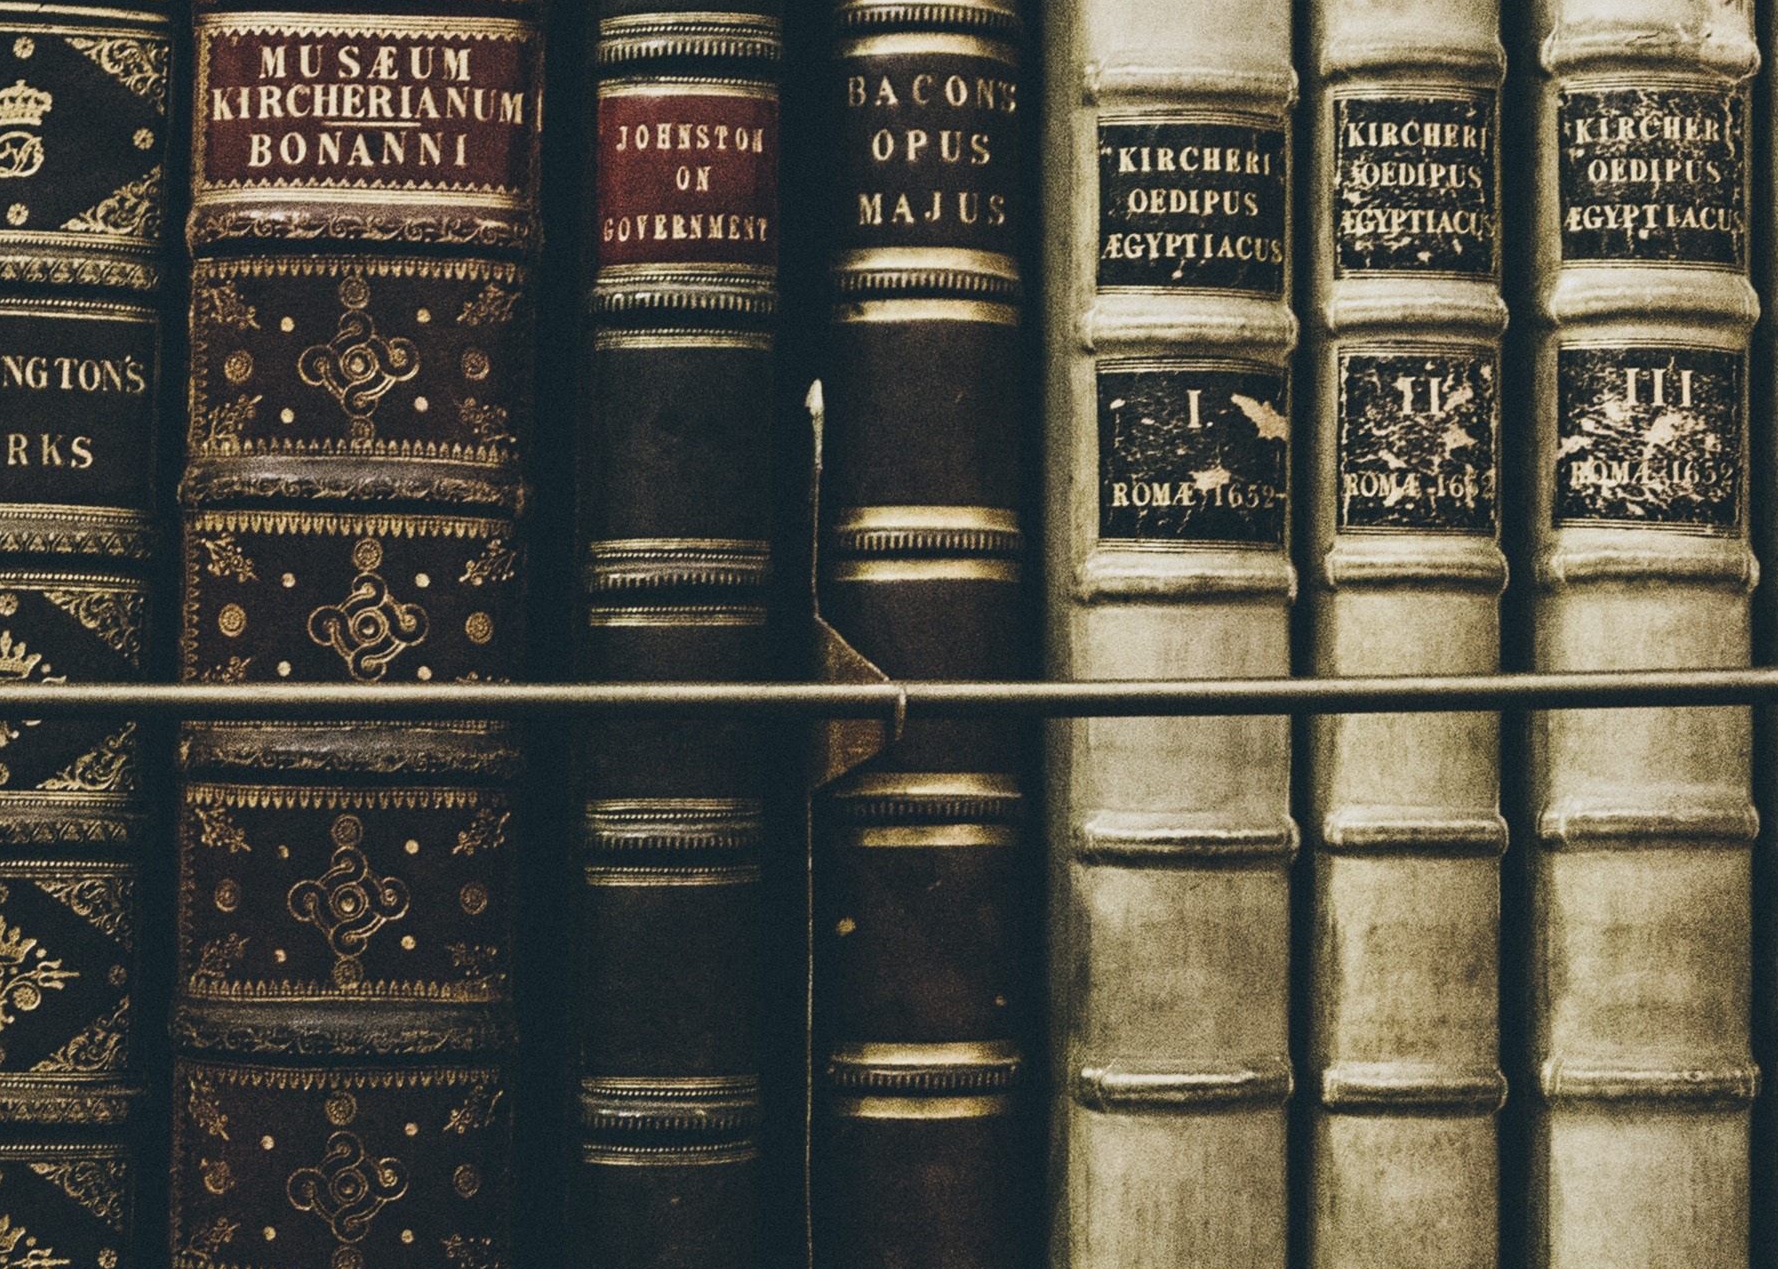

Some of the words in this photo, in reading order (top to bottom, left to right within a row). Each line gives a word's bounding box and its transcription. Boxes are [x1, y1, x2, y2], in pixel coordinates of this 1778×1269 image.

[258, 45, 471, 82] MUSÆUM
[210, 83, 524, 124] KIRCHERIANUM
[849, 75, 1017, 113] BACON'S
[248, 132, 467, 168] BONANNI
[616, 124, 764, 154] JOHNSTON
[872, 131, 990, 164] OPUS
[1347, 121, 1487, 149] KIRCHERI
[1118, 147, 1270, 176] KIRCHERI
[1361, 162, 1482, 188] OEDIPUS
[1588, 158, 1721, 184] OEDIPUS
[676, 166, 709, 192] ON
[858, 193, 1005, 226] MAJUS
[1128, 188, 1258, 217] OEDIPUS
[603, 215, 767, 242] GOVERNMENT
[1101, 233, 1283, 263] ÆGYPTIACUS
[1398, 377, 1443, 415] II
[1624, 367, 1693, 407] III
[1112, 482, 1196, 507] ROMÆ
